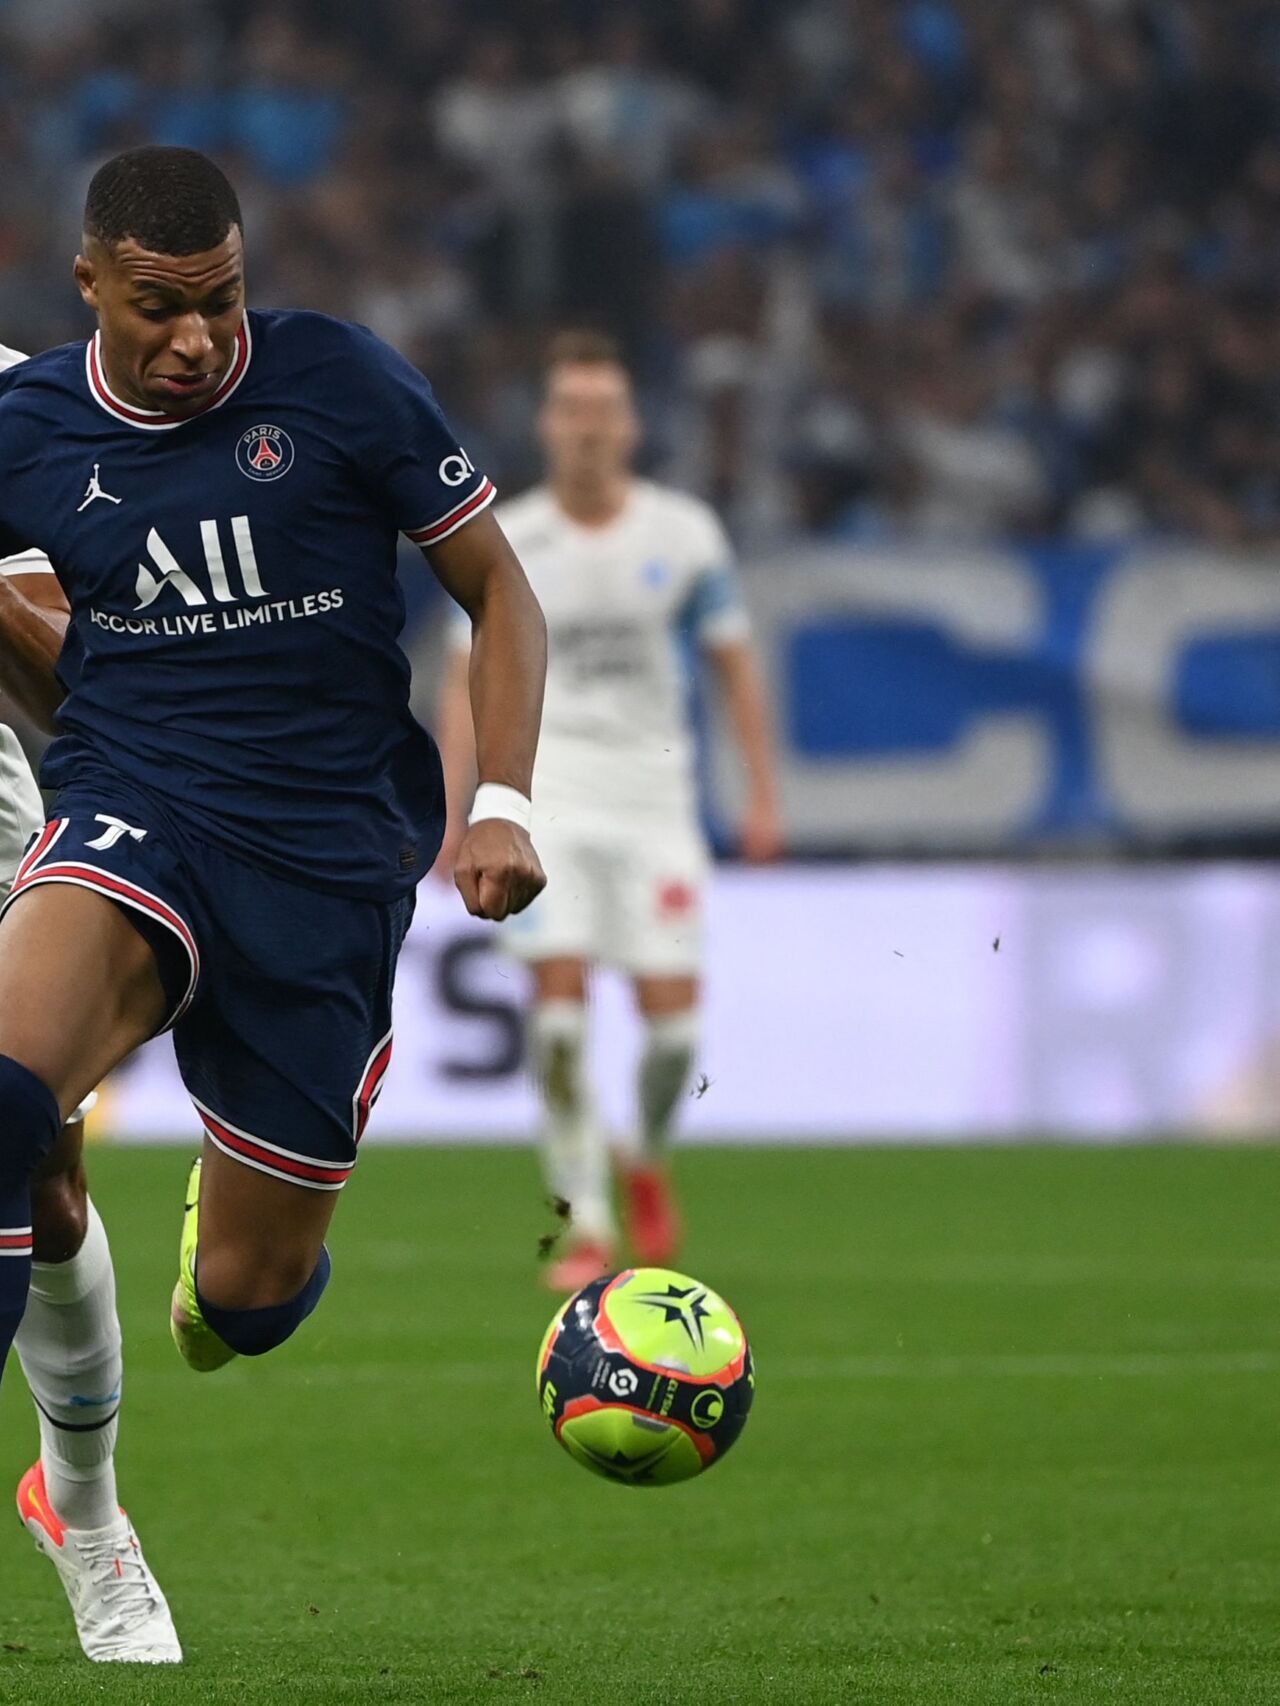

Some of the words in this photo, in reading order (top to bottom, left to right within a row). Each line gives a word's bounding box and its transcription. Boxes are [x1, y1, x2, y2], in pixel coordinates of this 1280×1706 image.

[243, 427, 281, 444] PARIS
[163, 613, 217, 636] LIVE
[222, 588, 345, 631] LIMITLESS
